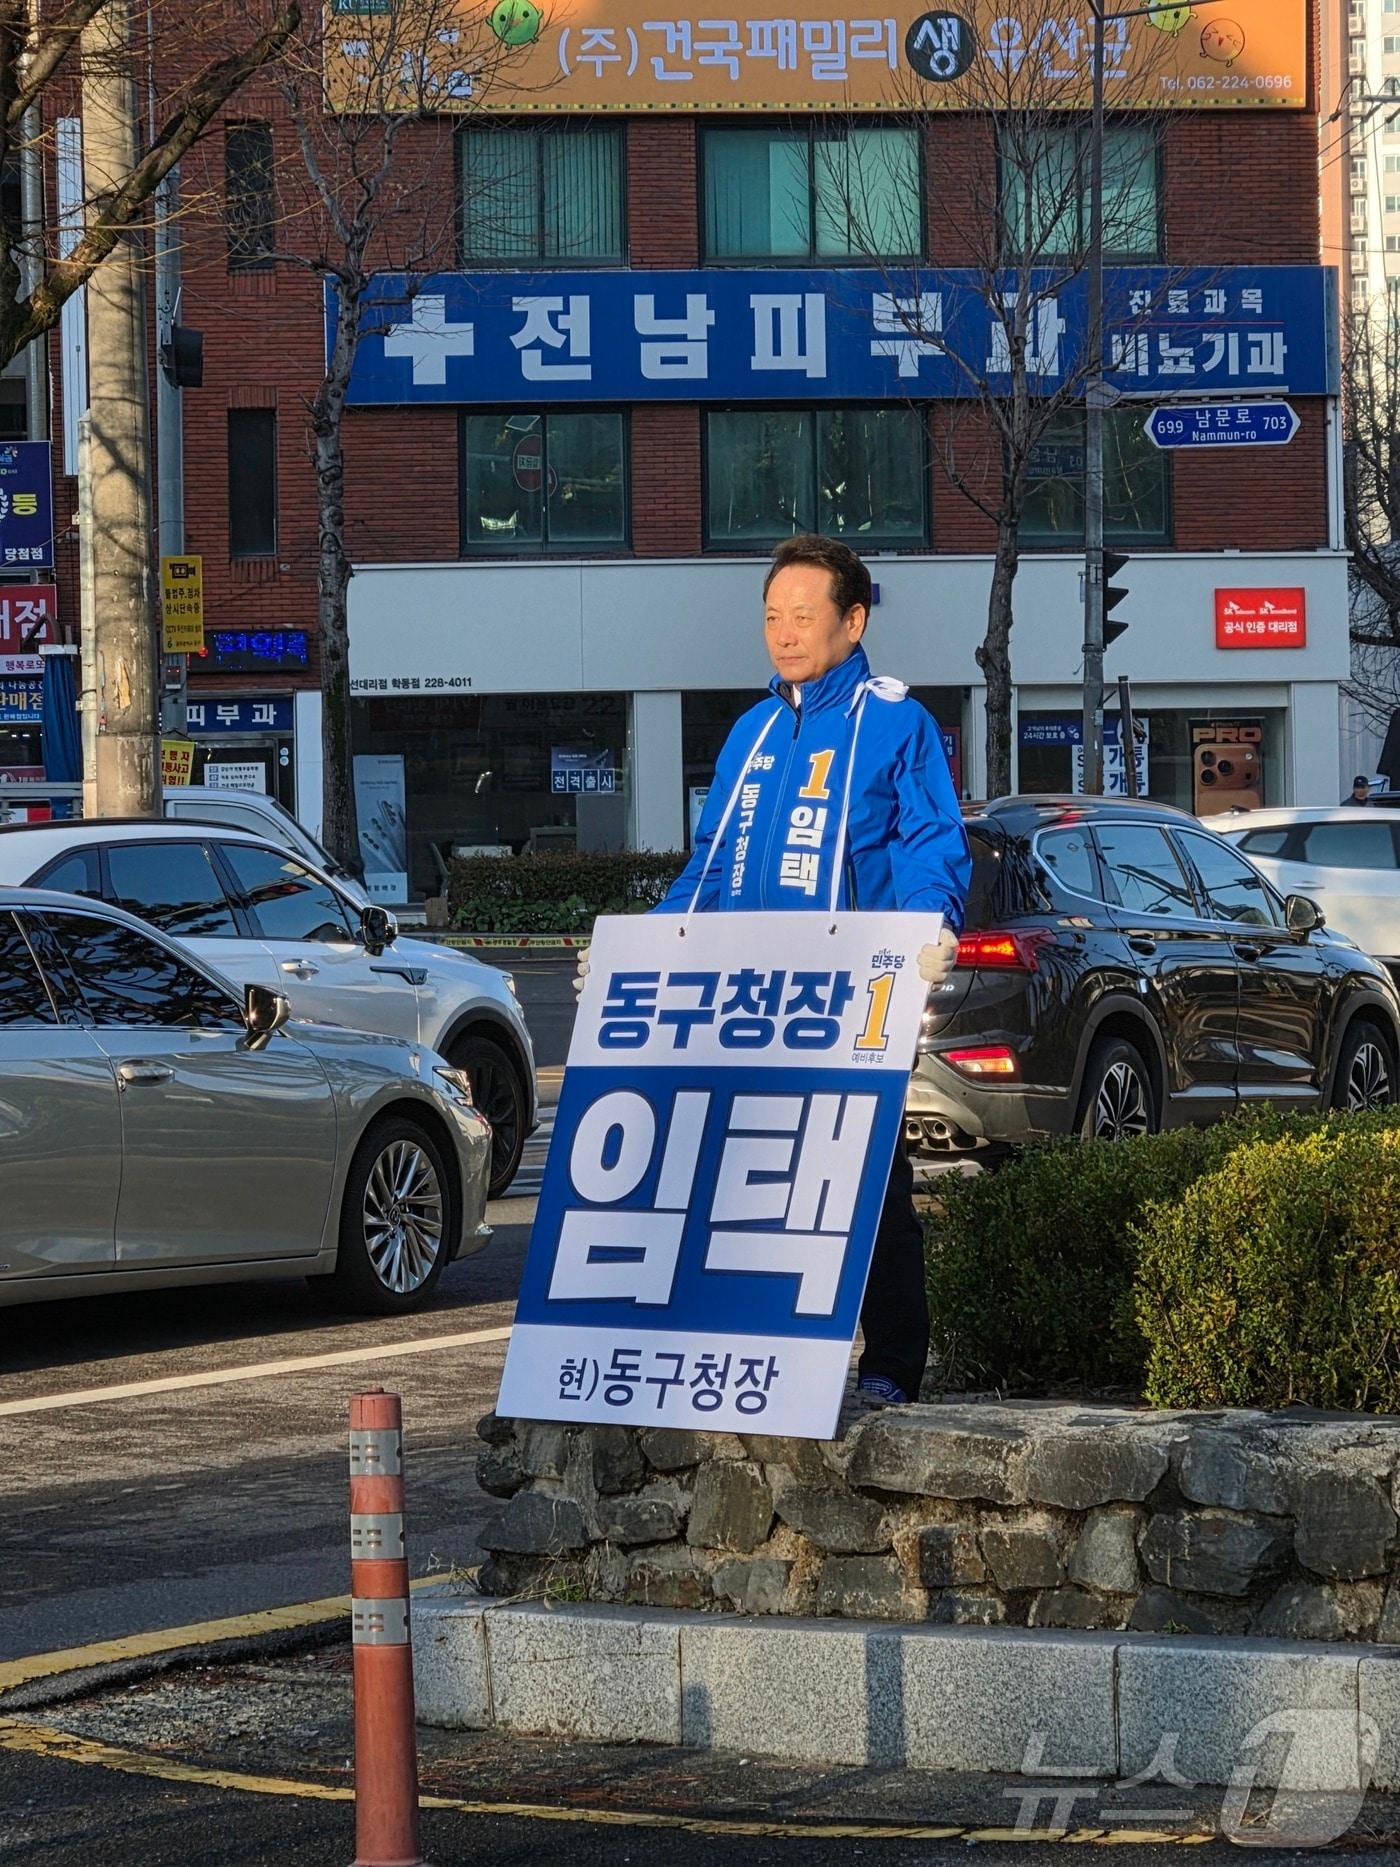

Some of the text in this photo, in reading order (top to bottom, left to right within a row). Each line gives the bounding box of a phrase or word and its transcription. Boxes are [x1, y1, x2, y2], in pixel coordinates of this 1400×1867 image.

[557, 16, 1131, 82] (주)건국패밀리 생 유산균
[1160, 75, 1292, 90] Tel. 062-224-0696
[1129, 288, 1263, 314] 진료과목
[509, 292, 1066, 382] 전남피부과
[1111, 332, 1288, 376] 비뇨기과
[1158, 408, 1287, 434] 699 남문로 703
[1192, 430, 1257, 442] Nammun-ro
[12, 493, 37, 515] 등
[0, 599, 47, 639] 점
[1224, 621, 1297, 634] 공식 인증 대리점
[425, 677, 472, 688] 228-4011
[187, 704, 277, 726] 피부과
[1193, 728, 1261, 743] PRO
[161, 762, 190, 774] 통사고
[799, 749, 836, 800] 1
[554, 775, 611, 789] 전격출시
[731, 783, 761, 889] 동구청장
[779, 806, 828, 897] 임택
[871, 954, 906, 969] 민주당
[597, 969, 897, 1052] 동구청장 1
[851, 1052, 885, 1064] 예비후보
[546, 1089, 882, 1317] 임택
[558, 1347, 780, 1415] 현)동구청장
